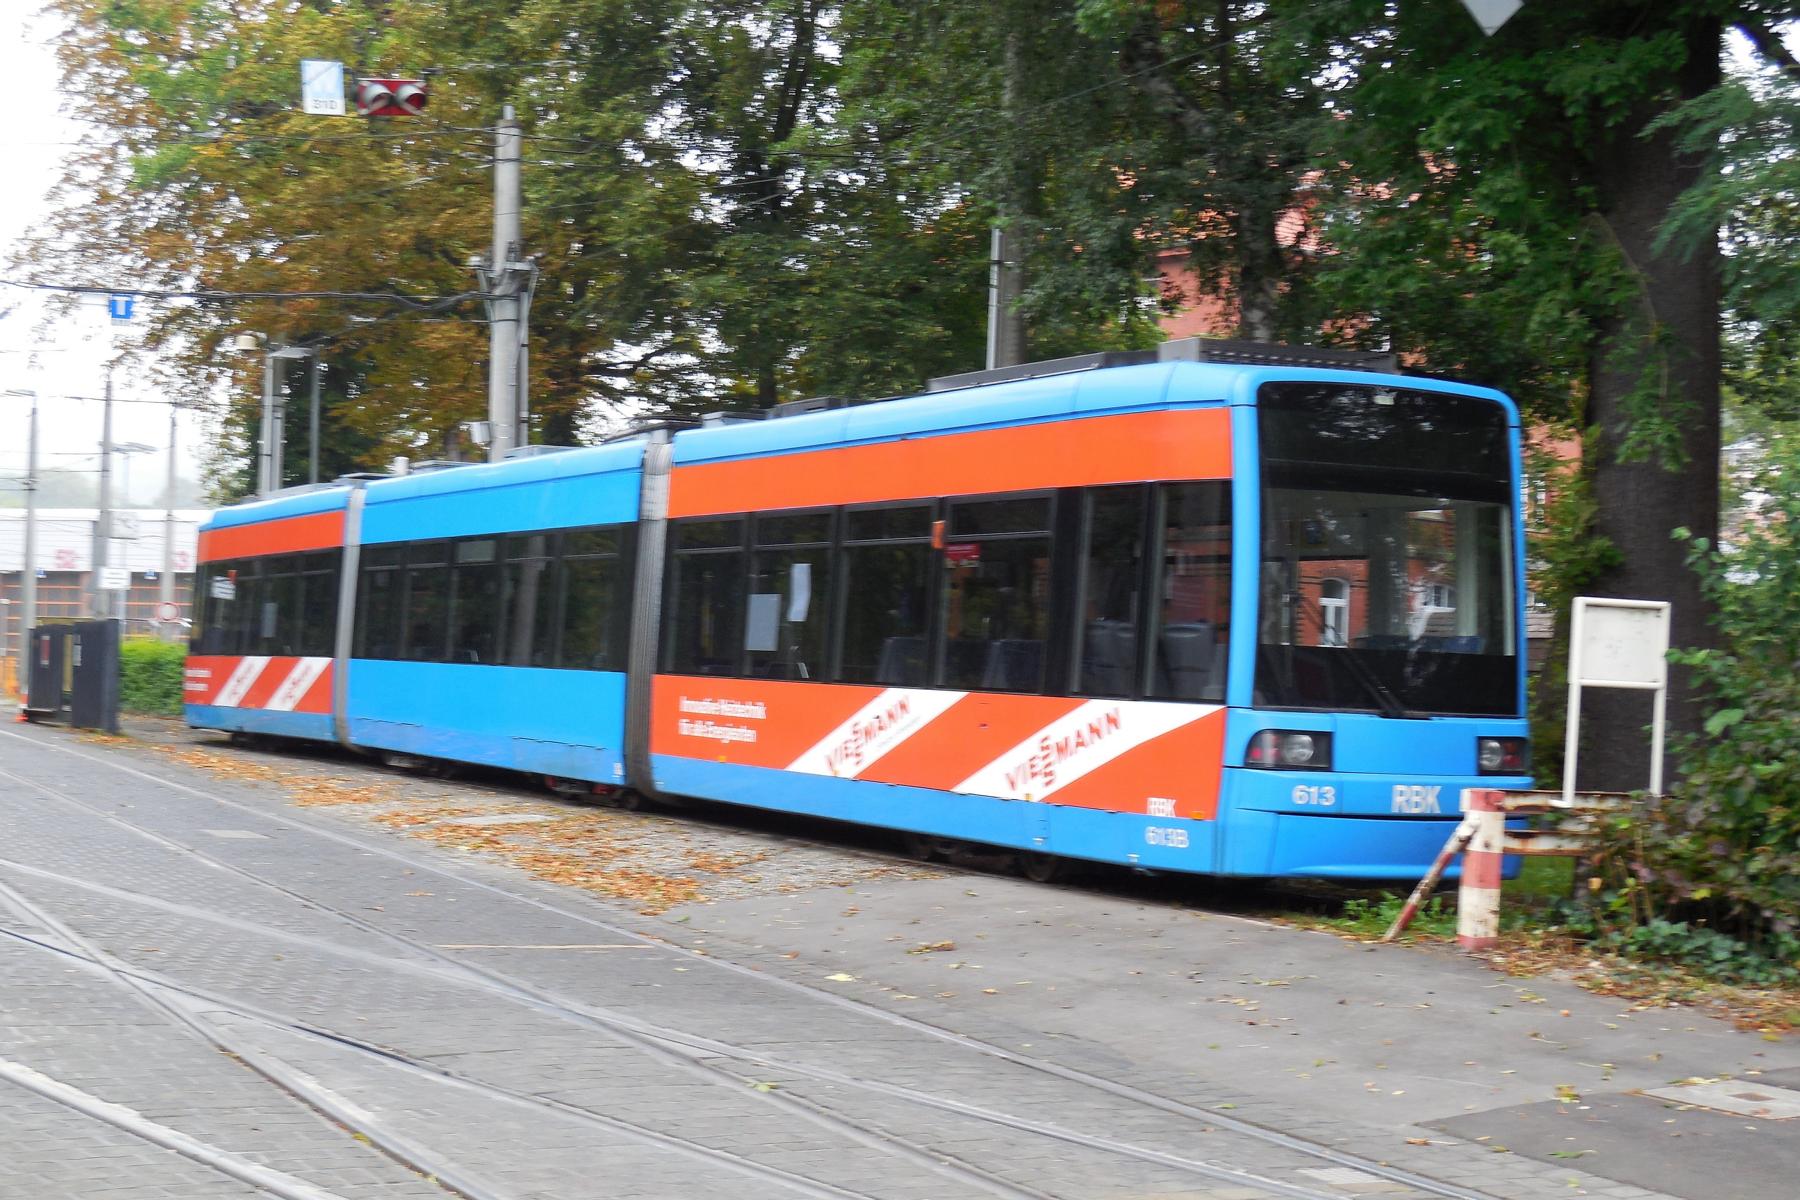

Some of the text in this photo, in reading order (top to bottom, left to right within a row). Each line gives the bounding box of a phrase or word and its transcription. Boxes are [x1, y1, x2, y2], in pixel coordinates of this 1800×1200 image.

[1005, 707, 1121, 791] VIESSMANN
[1292, 784, 1336, 806] 613
[1391, 785, 1442, 814] RBK
